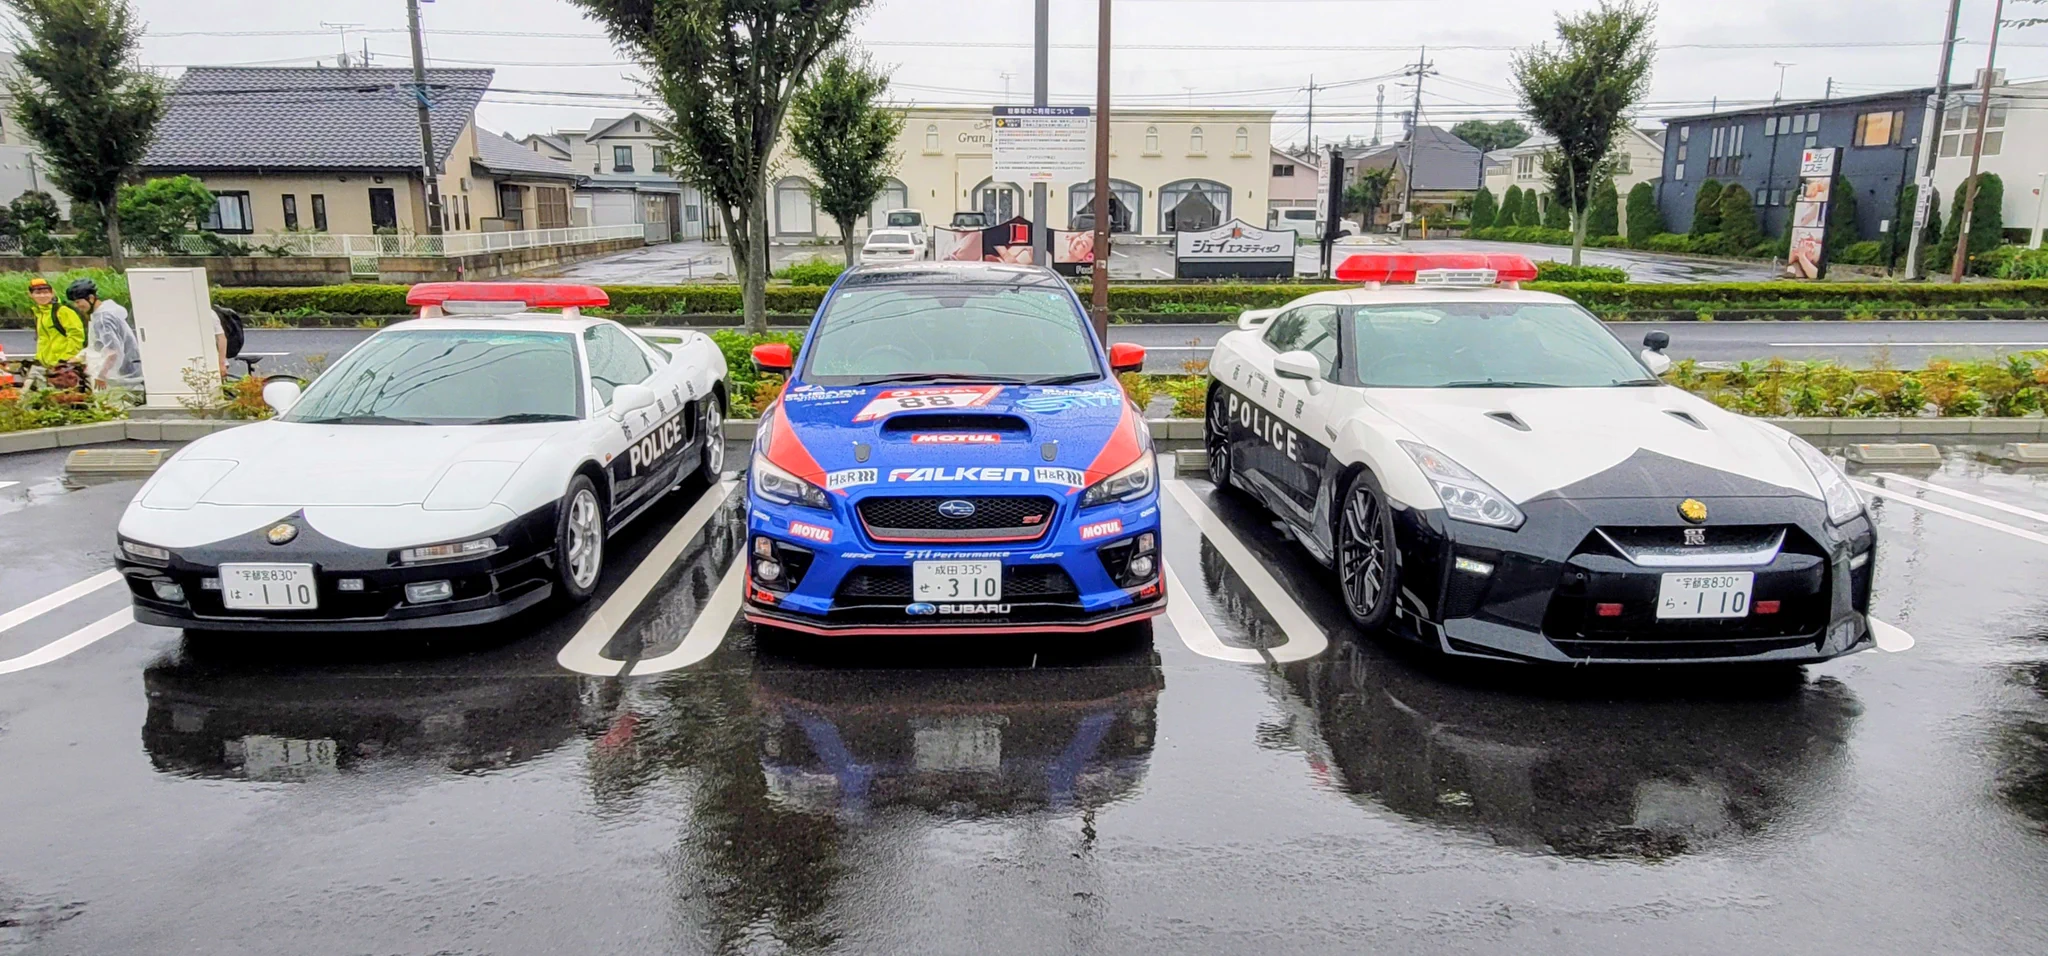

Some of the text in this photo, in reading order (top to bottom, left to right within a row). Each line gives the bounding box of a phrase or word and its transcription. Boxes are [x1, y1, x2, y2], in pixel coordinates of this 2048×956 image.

[958, 132, 986, 144] Gran
[1191, 239, 1230, 253] ジェイ
[897, 395, 954, 409] 88
[1228, 393, 1298, 462] POLICE
[915, 434, 996, 442] MOTUL
[629, 416, 682, 477] POLICE
[829, 467, 1065, 486] H&R FALKEN H&R
[791, 523, 830, 541] MOTUL
[1082, 521, 1121, 539] MOTUL
[933, 551, 1011, 559] Performance
[935, 565, 982, 575] 成田 335
[939, 604, 1011, 614] SUBARU
